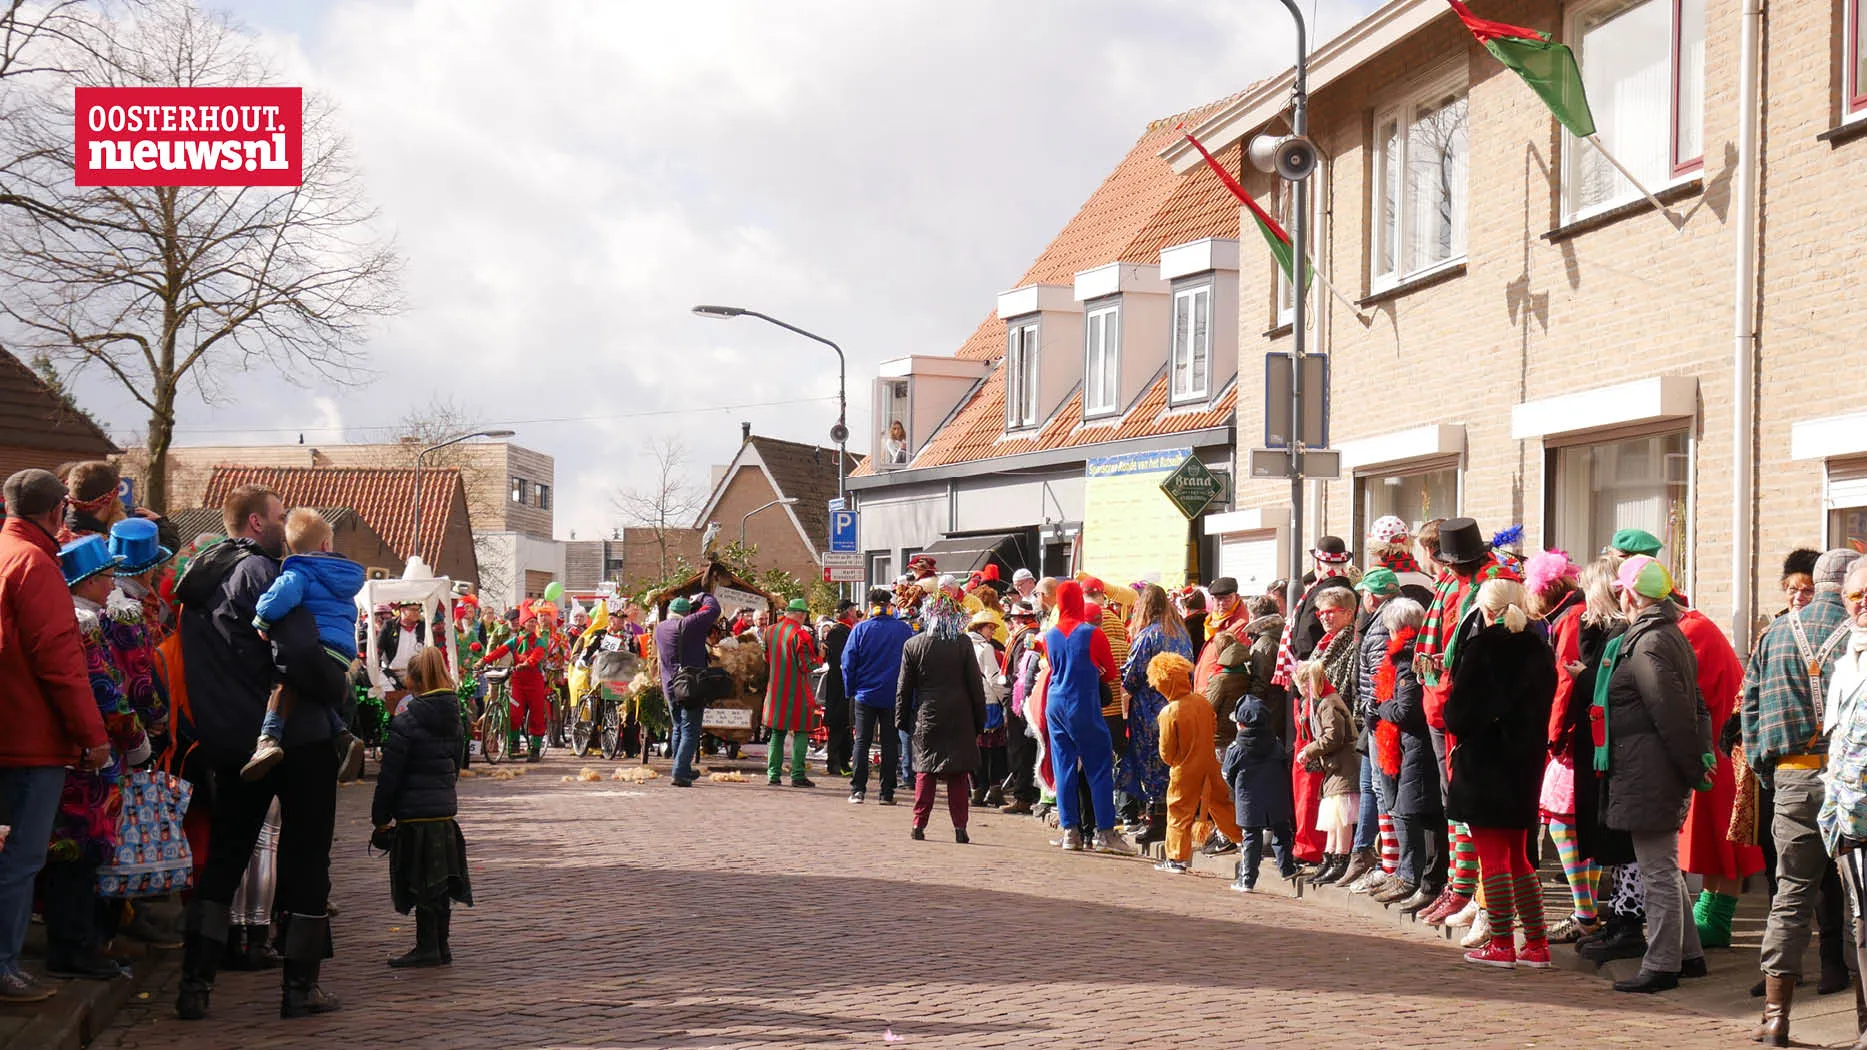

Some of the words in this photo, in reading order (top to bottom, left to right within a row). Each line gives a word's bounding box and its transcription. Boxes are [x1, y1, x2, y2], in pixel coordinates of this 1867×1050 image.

[1175, 475, 1212, 487] Brand
[837, 513, 852, 535] P
[604, 641, 617, 650] 26
